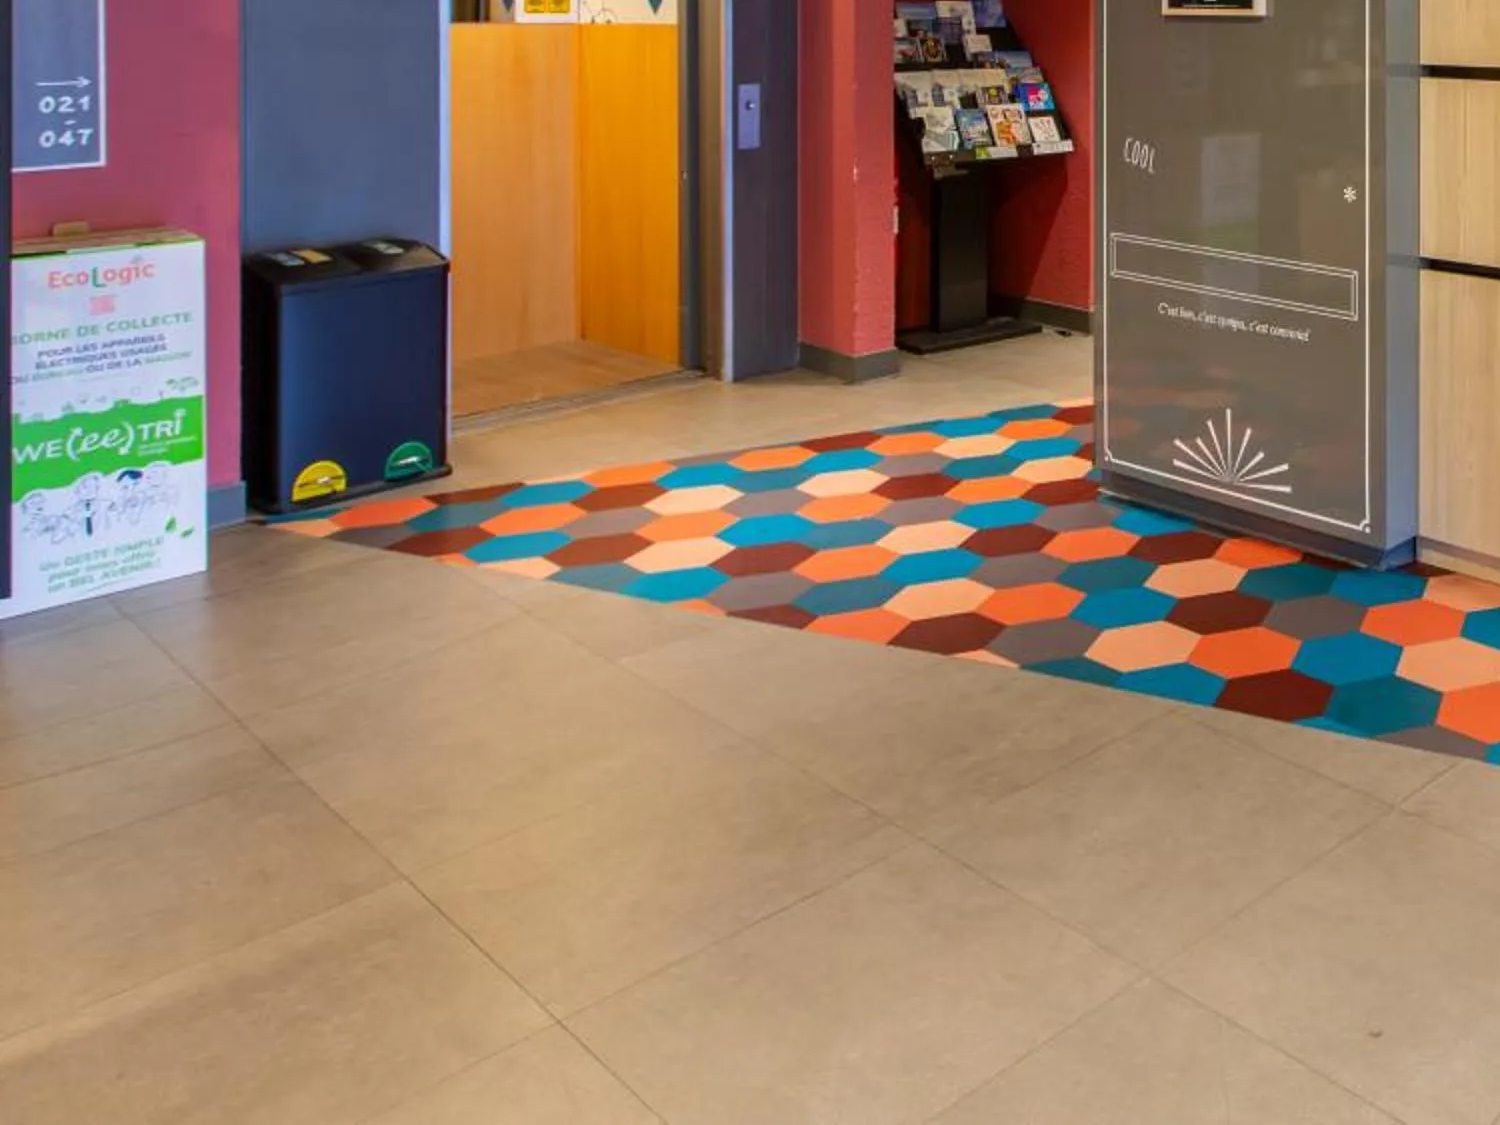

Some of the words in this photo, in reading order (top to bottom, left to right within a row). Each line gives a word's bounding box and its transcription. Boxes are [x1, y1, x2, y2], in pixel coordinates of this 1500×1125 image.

[38, 95, 91, 114] 021
[38, 128, 94, 148] 047
[76, 325, 100, 338] DE
[106, 312, 193, 333] COLLECTE
